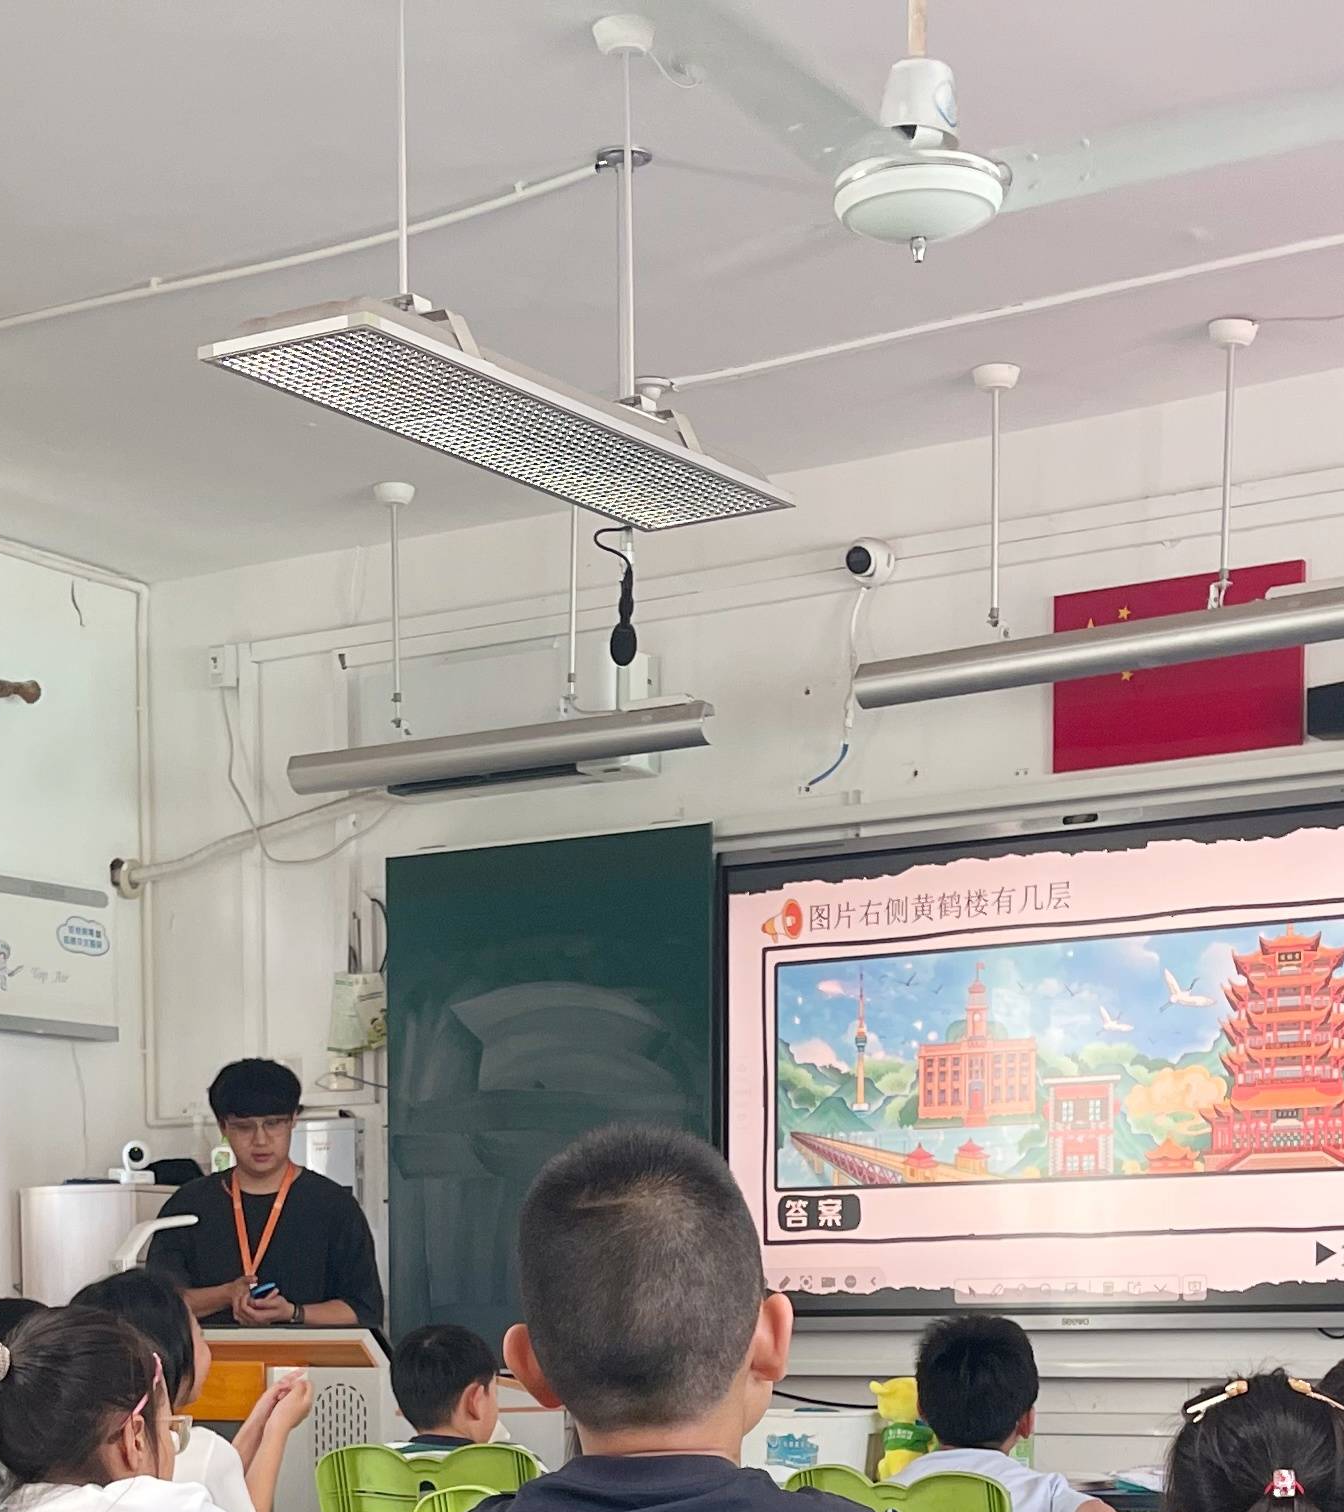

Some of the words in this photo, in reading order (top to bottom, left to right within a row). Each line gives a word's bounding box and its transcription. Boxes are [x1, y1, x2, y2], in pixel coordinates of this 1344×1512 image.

[809, 880, 1071, 932] 图片右侧黄鹤楼有几层
[785, 1198, 844, 1229] 答案
